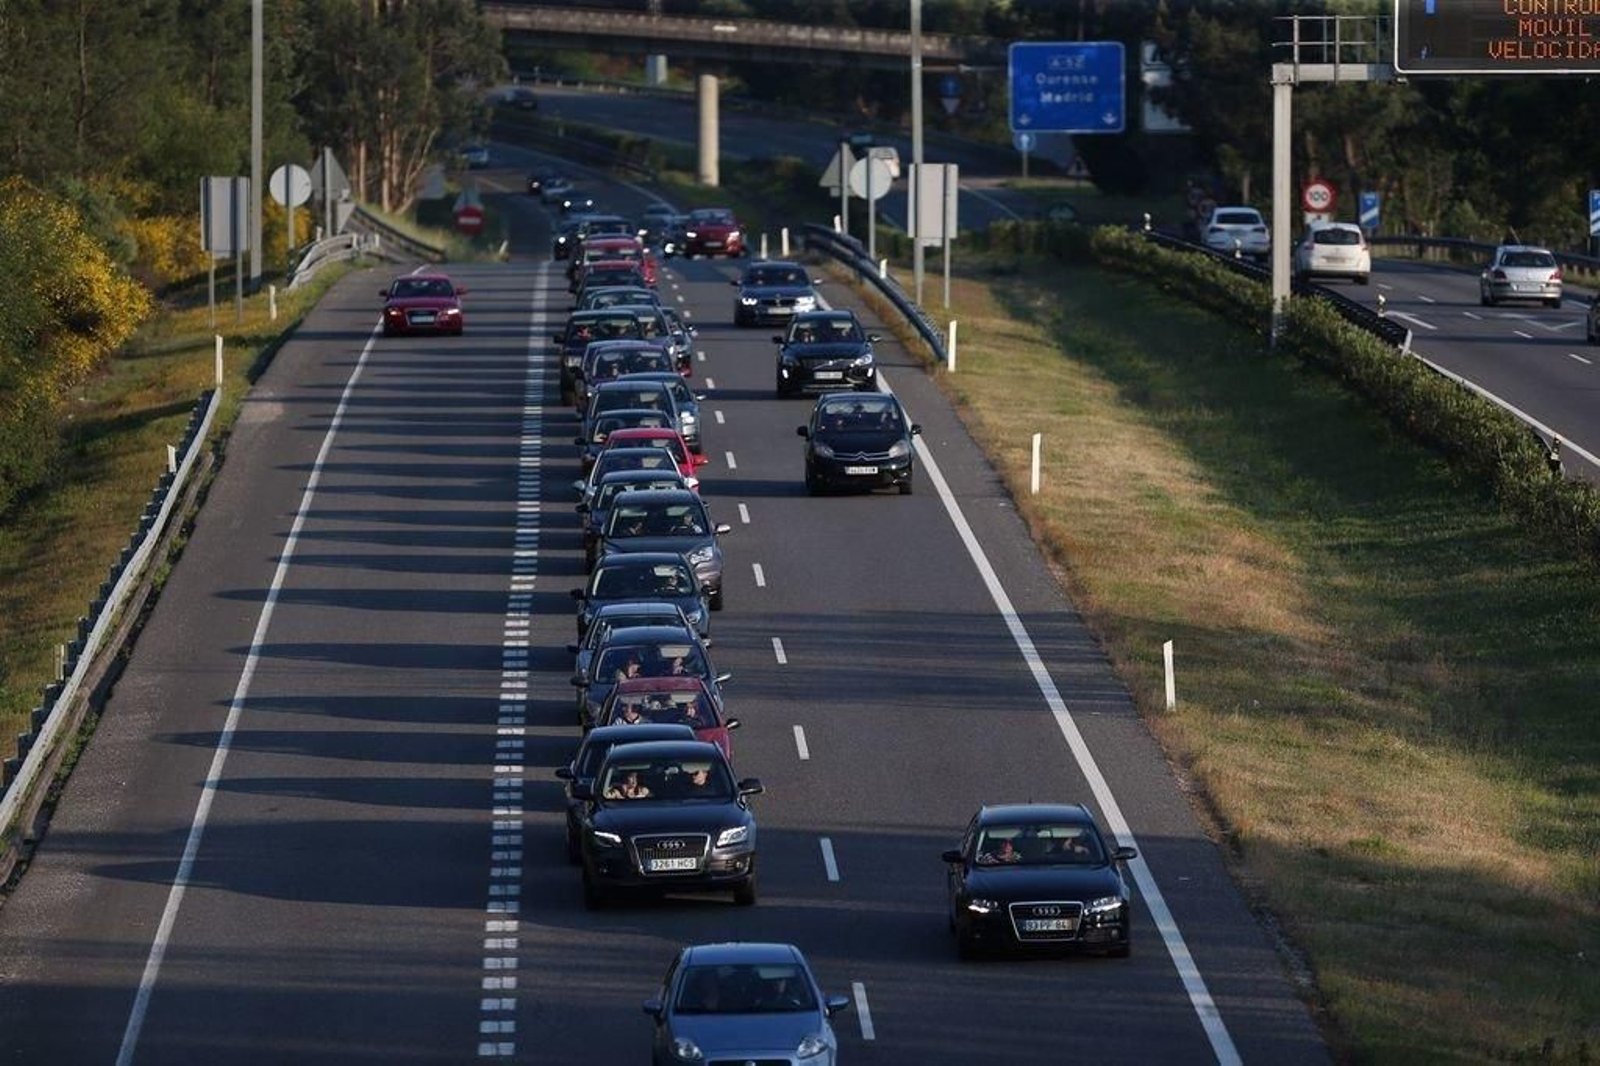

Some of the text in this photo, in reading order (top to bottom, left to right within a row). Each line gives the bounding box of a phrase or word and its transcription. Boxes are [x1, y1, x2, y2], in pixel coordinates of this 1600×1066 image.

[1519, 19, 1592, 36] MOVIL
[1036, 73, 1098, 84] Ourense
[1040, 92, 1094, 103] Madrid
[1309, 187, 1329, 201] 100
